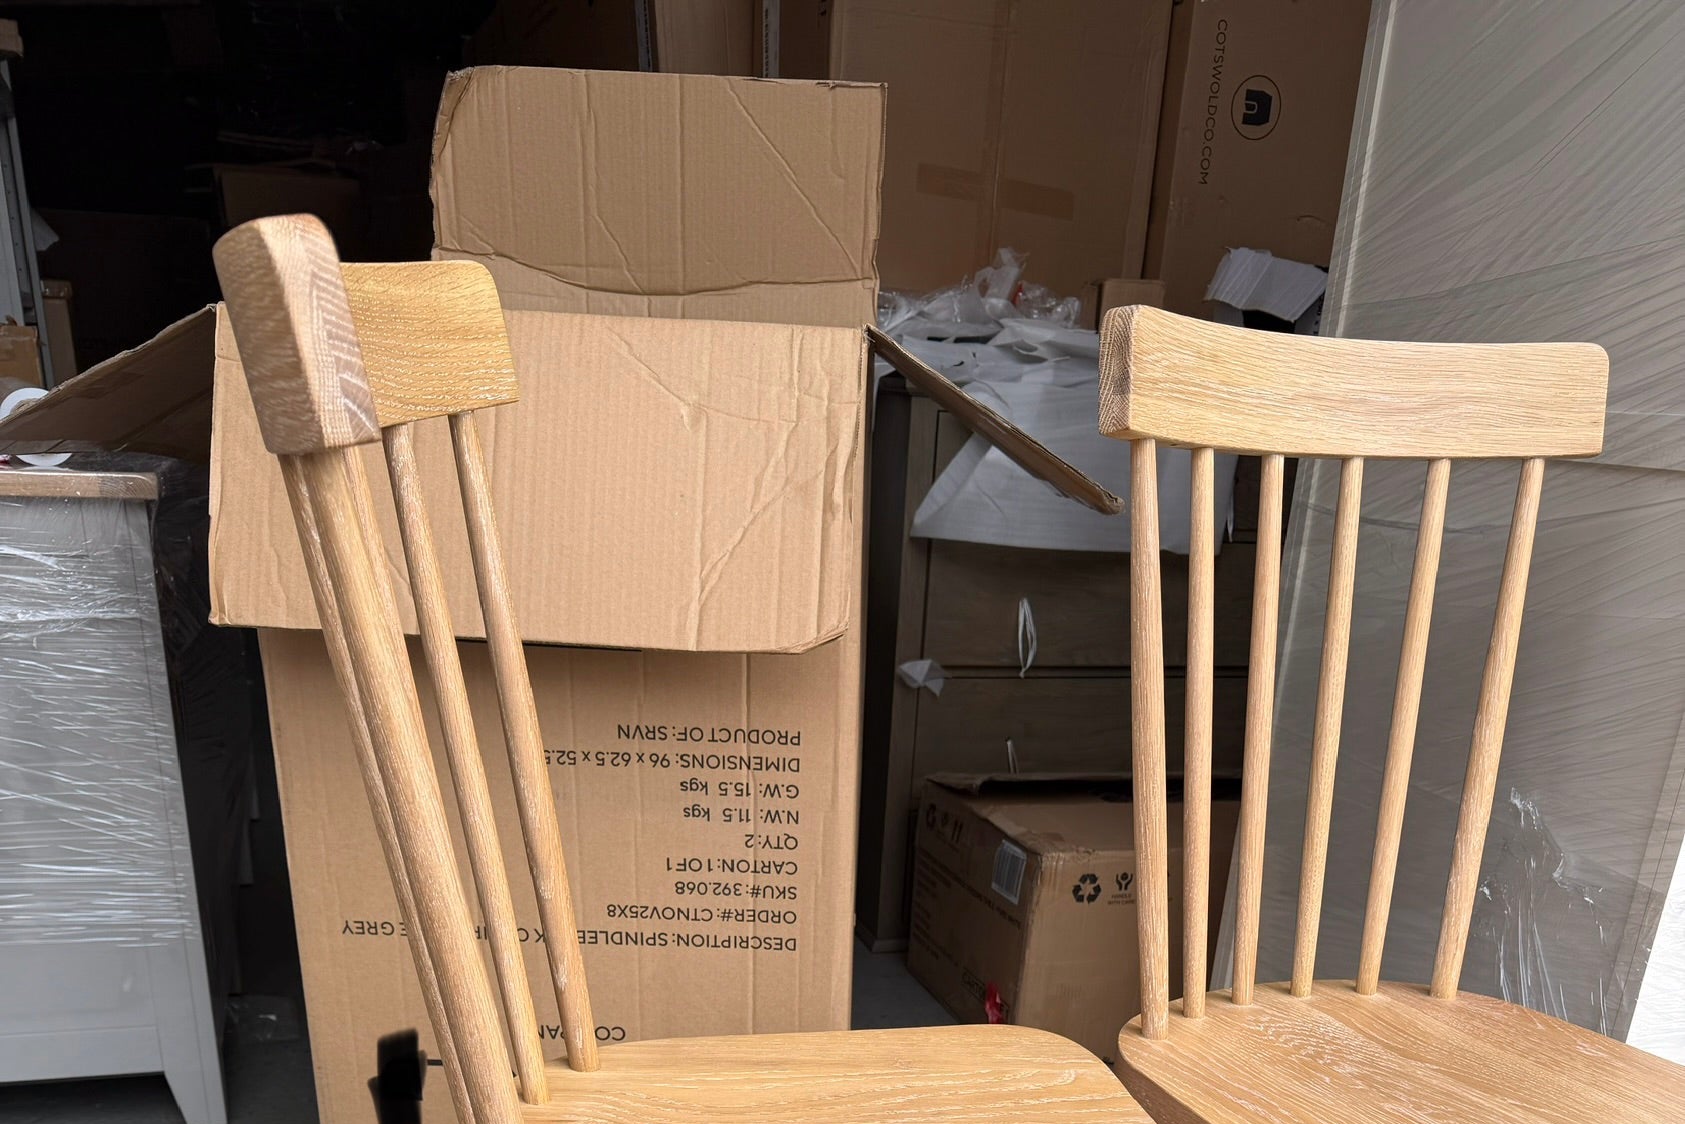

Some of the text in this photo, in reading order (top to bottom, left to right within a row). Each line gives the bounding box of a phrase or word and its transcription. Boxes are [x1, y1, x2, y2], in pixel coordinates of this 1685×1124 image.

[1198, 19, 1228, 185] COTSWOLDCO.COM
[617, 724, 801, 746] PRODUCT OF: SRVN
[582, 750, 591, 762] x
[594, 751, 631, 767] 62.5
[636, 752, 645, 764] x
[649, 753, 671, 768] 96
[675, 753, 800, 772] DIMENSIONS:
[679, 777, 800, 799] G.W: 15.5 kgs
[683, 804, 799, 824] N.W: 11.5 kgs
[744, 833, 799, 851] QTY: 2
[666, 856, 798, 875] CARTON: 1 OF 1
[674, 881, 798, 900] SKU#: 392.068
[606, 904, 797, 924] ORDER#: CTNOV25X8
[342, 920, 395, 936] GREY
[535, 928, 668, 947] SPINDLEBK
[671, 933, 797, 952] DESCRIPTION:
